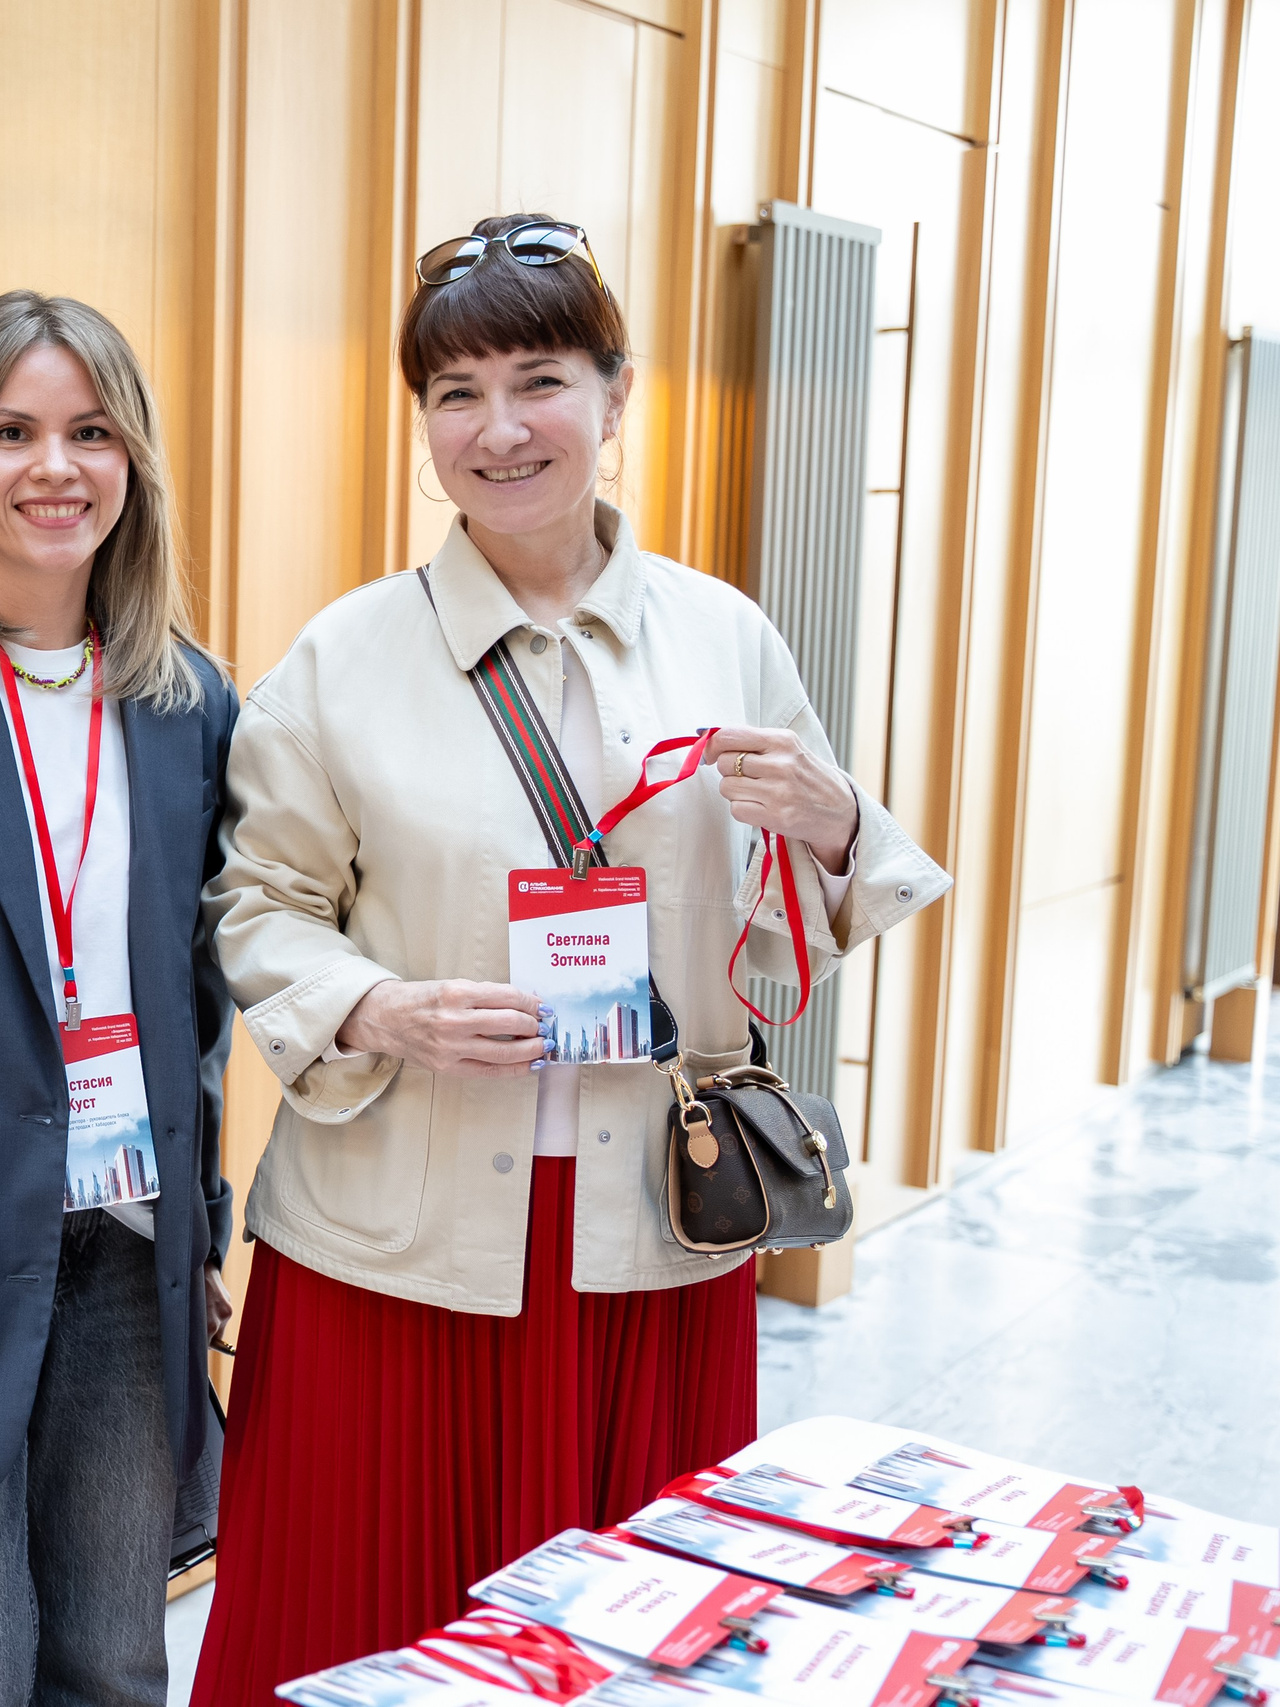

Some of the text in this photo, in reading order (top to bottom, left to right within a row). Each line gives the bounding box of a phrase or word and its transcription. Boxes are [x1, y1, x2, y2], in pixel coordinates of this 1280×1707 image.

[546, 932, 610, 946] Светлана
[550, 952, 606, 967] Зоткина
[605, 1577, 663, 1614] Кубарева
